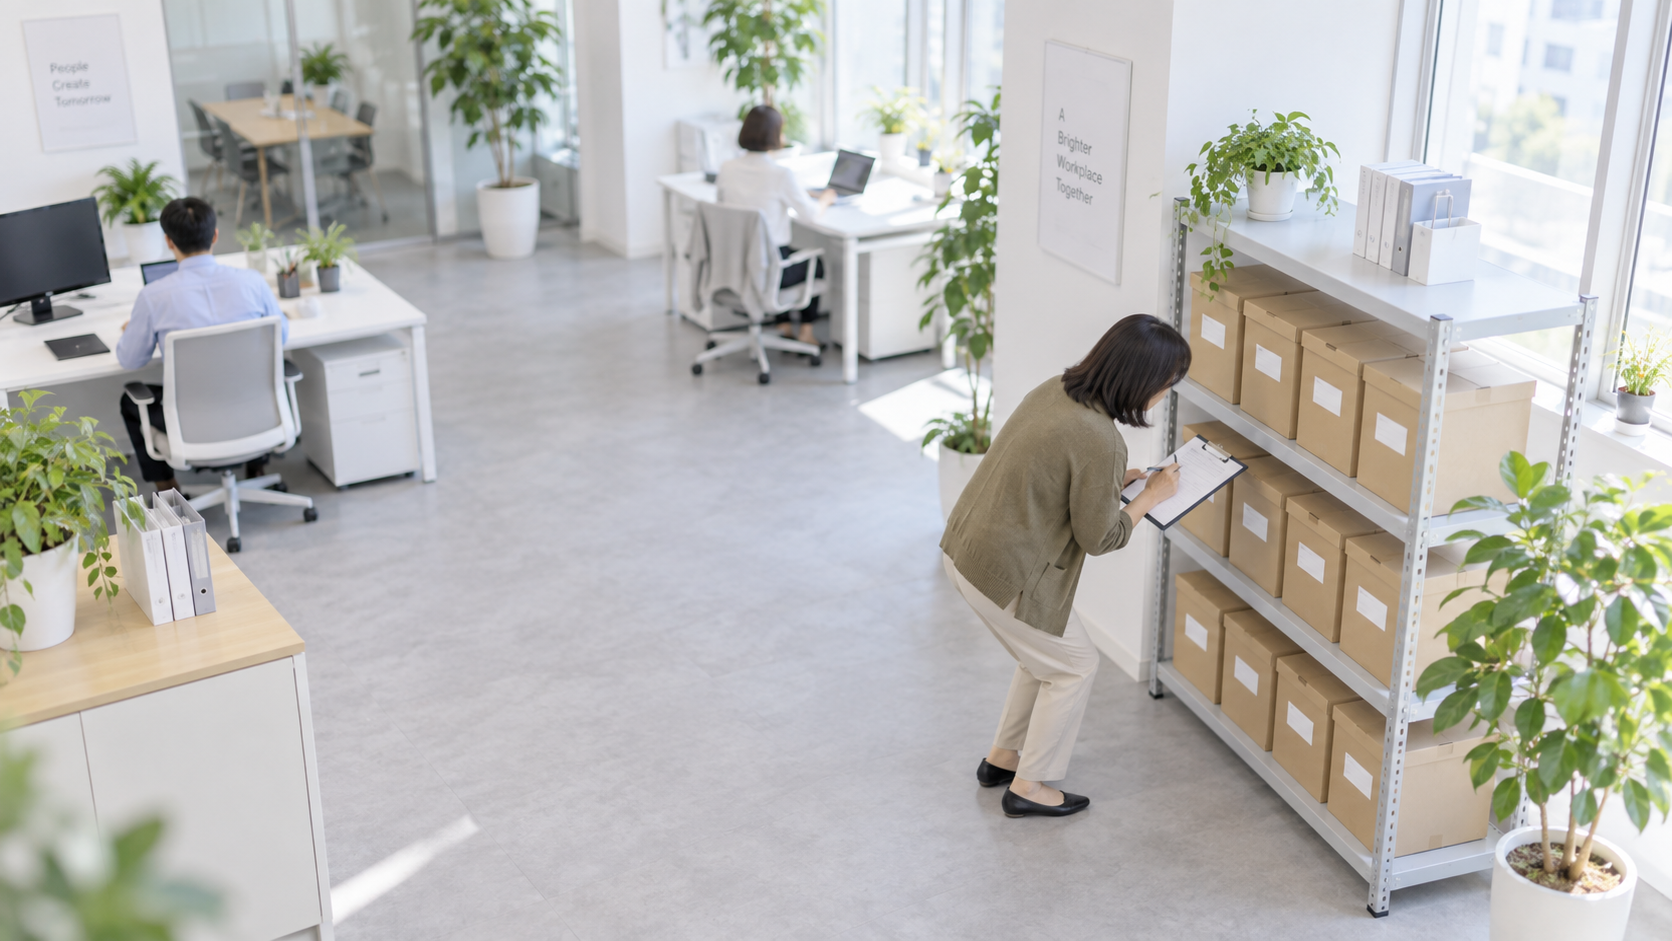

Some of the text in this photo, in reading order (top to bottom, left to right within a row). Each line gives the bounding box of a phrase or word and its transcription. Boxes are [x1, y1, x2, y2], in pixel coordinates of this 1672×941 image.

[50, 60, 89, 74] People
[52, 79, 90, 91] Create
[55, 94, 111, 107] Tomorrow
[1058, 108, 1065, 122] A
[1058, 130, 1092, 155] Brighter
[1056, 153, 1103, 185] Workplace
[1056, 177, 1093, 205] Together
